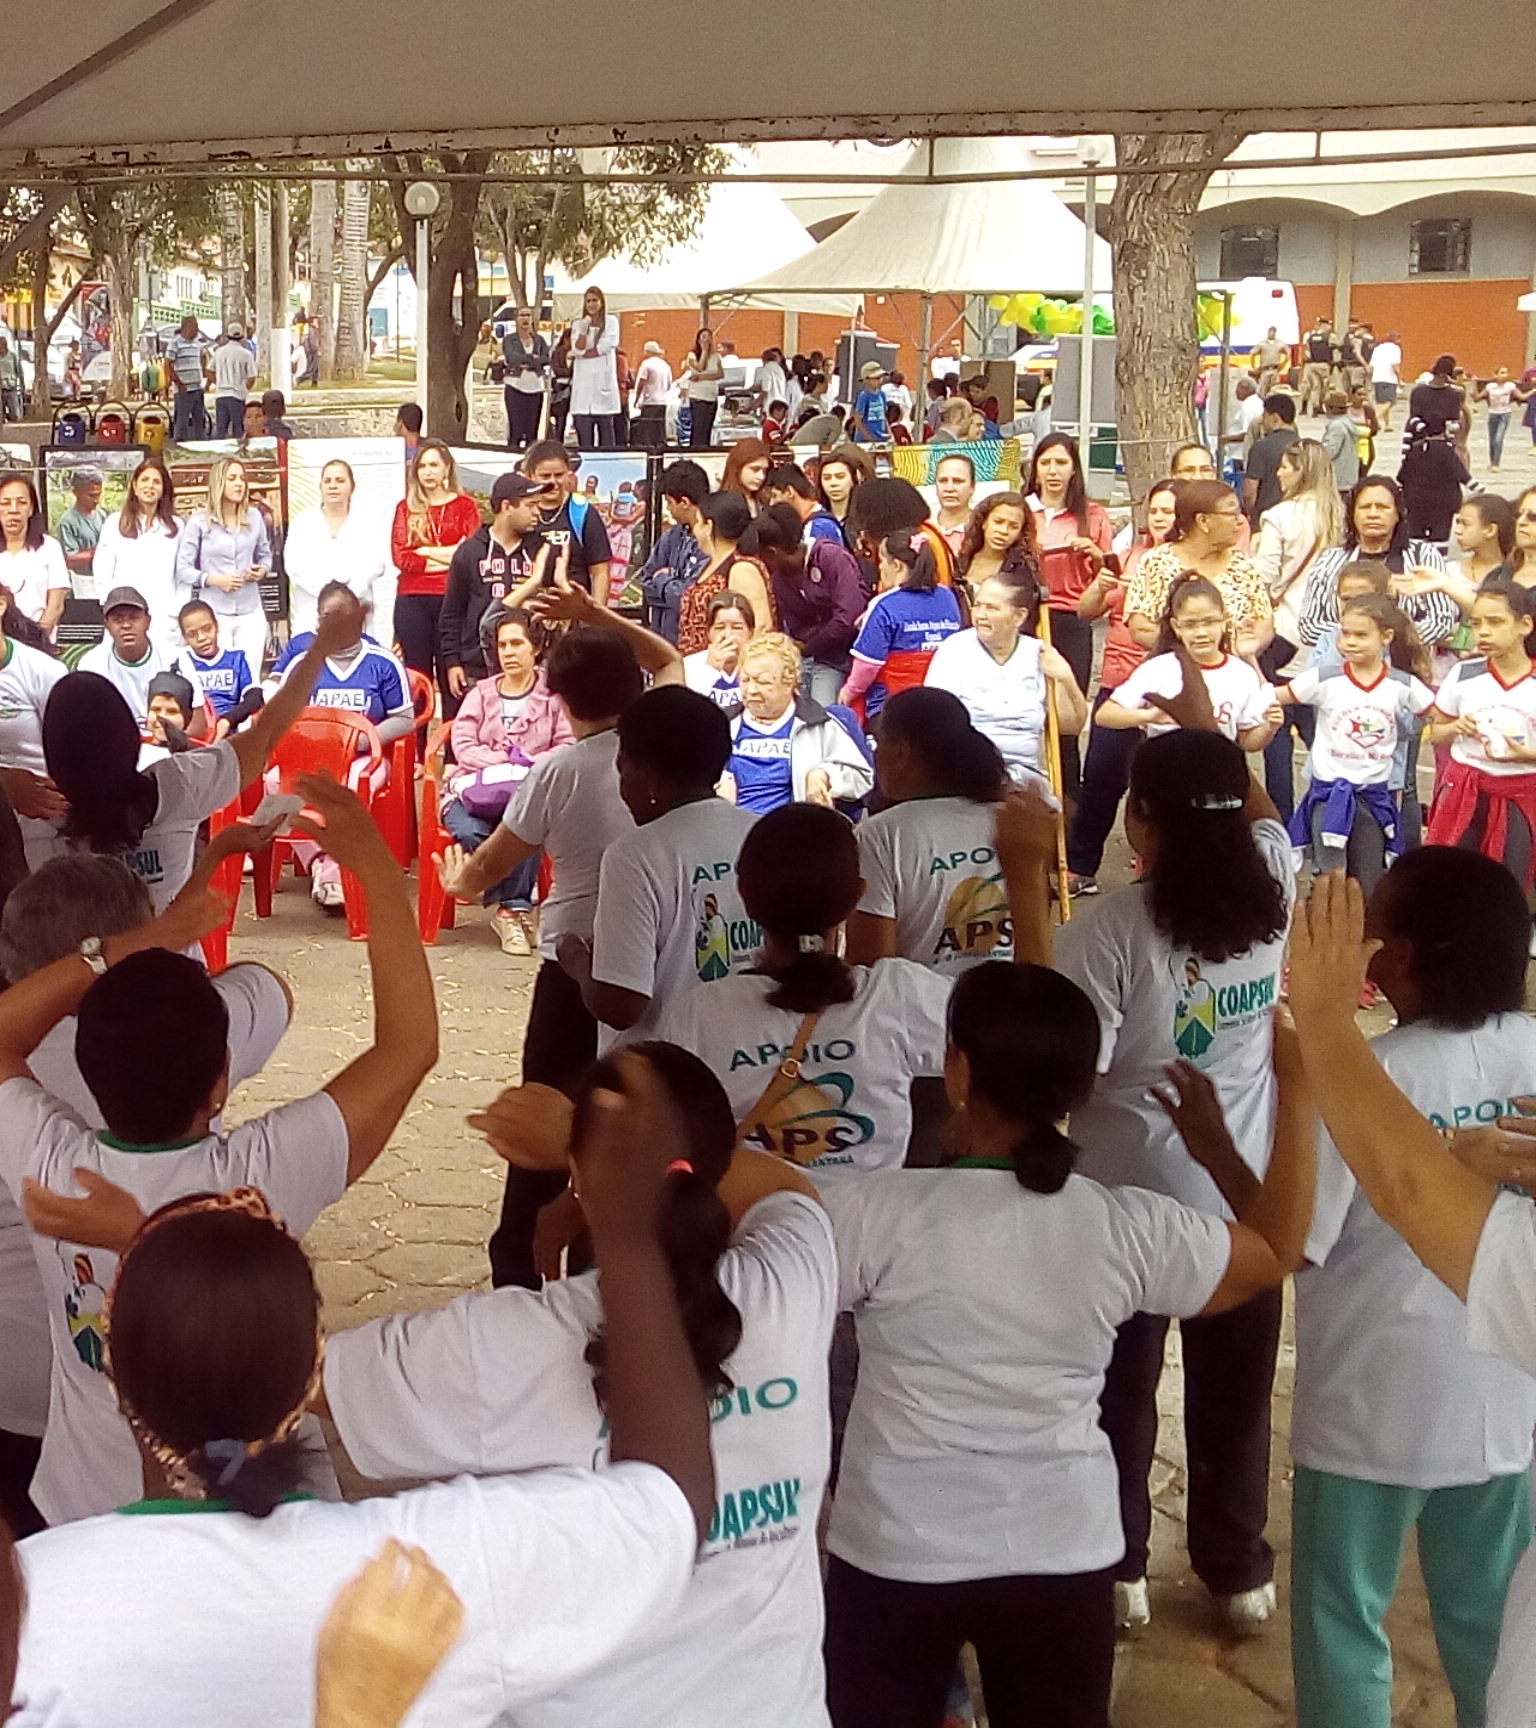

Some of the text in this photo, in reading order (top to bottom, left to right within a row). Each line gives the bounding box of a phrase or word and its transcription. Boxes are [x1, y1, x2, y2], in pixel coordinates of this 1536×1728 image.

[318, 692, 364, 708] APAE
[709, 690, 740, 706] APA
[744, 741, 791, 755] APAE
[929, 847, 994, 875] APO
[933, 918, 1014, 954] APS
[743, 1123, 854, 1156] APS
